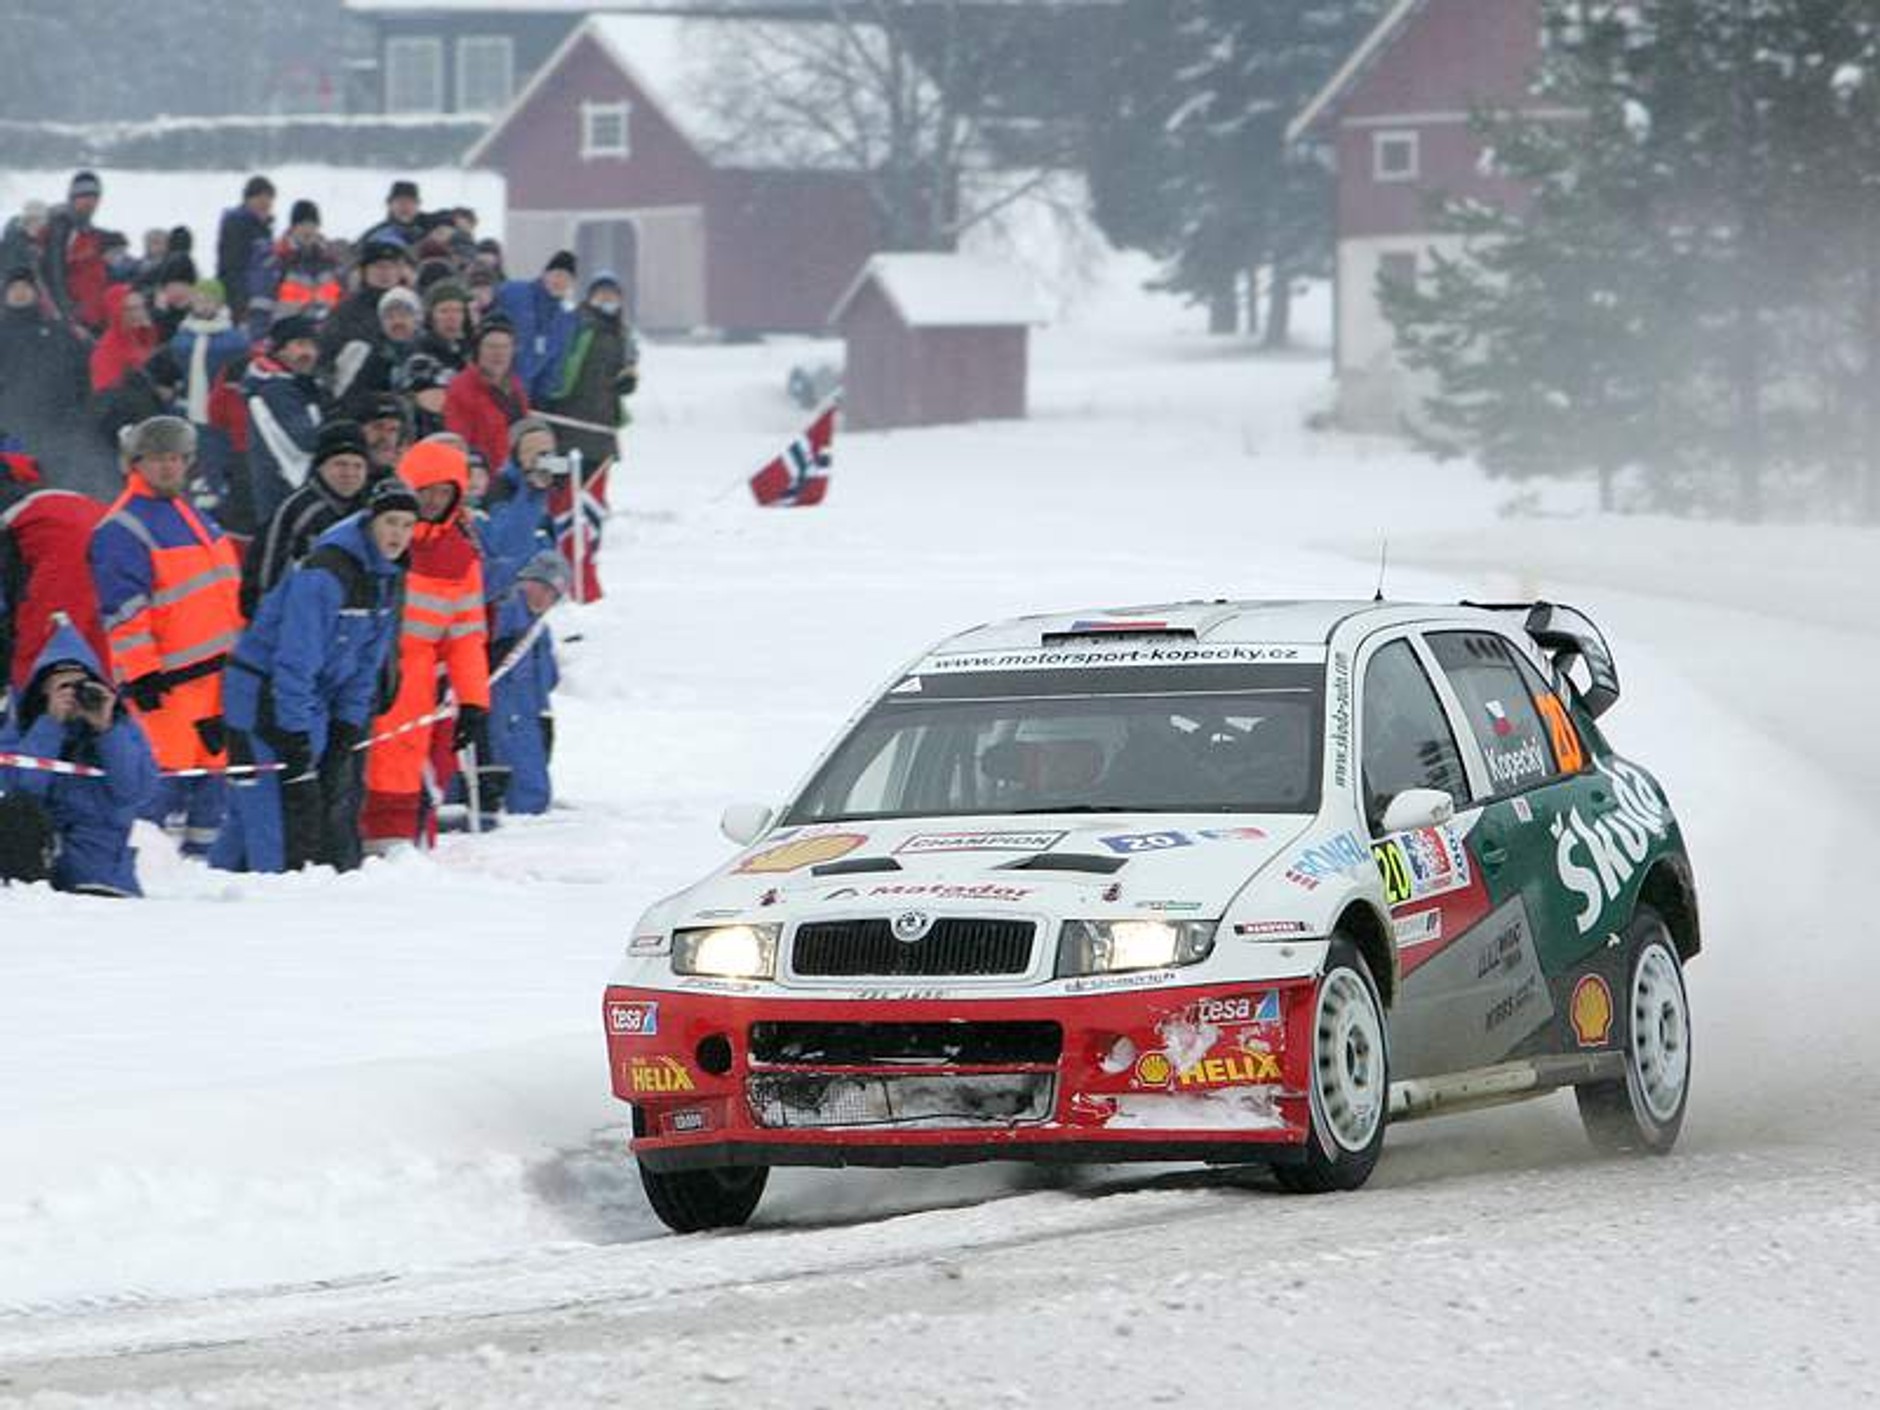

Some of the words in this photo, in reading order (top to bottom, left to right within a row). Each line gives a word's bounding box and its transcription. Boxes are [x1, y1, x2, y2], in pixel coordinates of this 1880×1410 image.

[935, 647, 1298, 670] www.motorsport-kopecky.cz
[1483, 736, 1547, 786] Kopecký
[911, 834, 1052, 849] CHAMPION
[1120, 835, 1174, 850] 20
[1372, 840, 1411, 904] 20
[611, 1005, 641, 1029] tesa
[1199, 998, 1250, 1021] tesa
[631, 1056, 695, 1092] HELIX
[1179, 1050, 1282, 1085] HELIX
